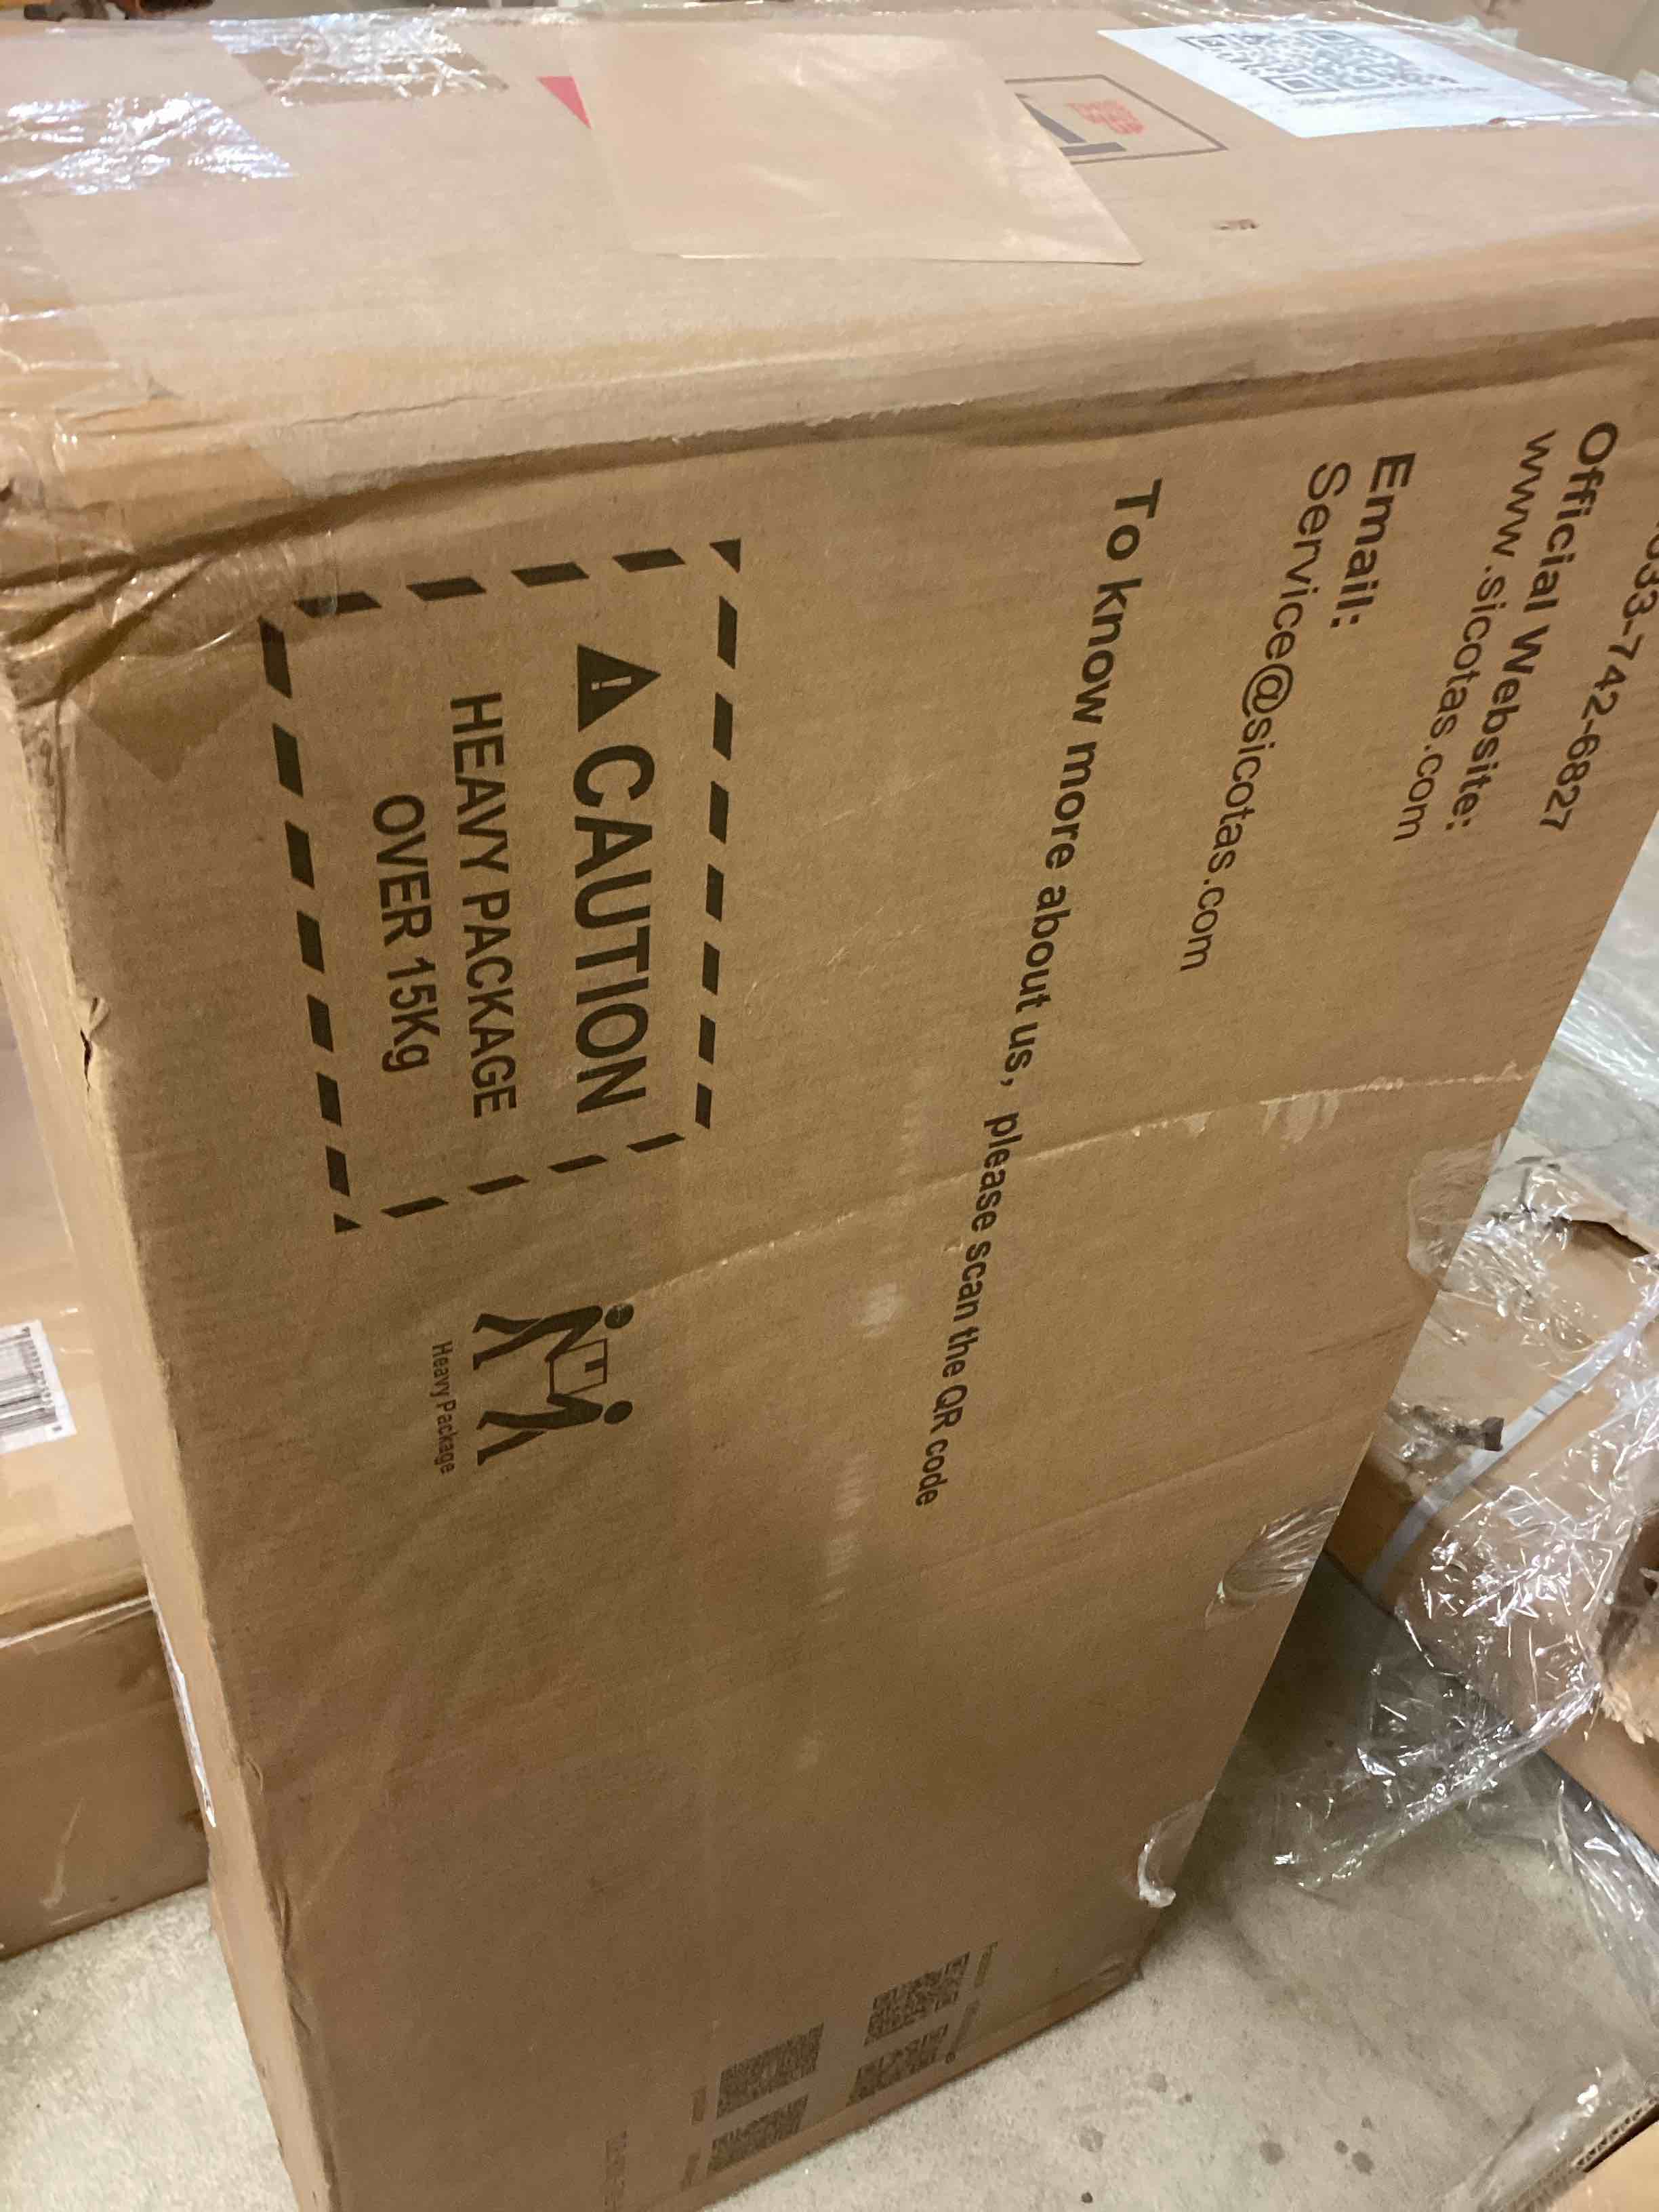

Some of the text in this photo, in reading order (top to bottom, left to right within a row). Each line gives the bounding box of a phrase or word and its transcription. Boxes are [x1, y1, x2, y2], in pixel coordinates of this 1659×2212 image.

[1180, 462, 1351, 971] Service@sicotas.com
[1330, 453, 1416, 628] Email:
[1393, 430, 1556, 842] www.sicotas.com
[1446, 422, 1618, 830] Official Website:
[372, 795, 440, 1072] OVER 15Kg
[450, 692, 516, 1118] HEAVY PACKAGE
[573, 745, 655, 1114] CAUTION
[916, 477, 1163, 1506] To know more about us, please scan the QR code
[430, 1341, 457, 1475] Heavy Package
